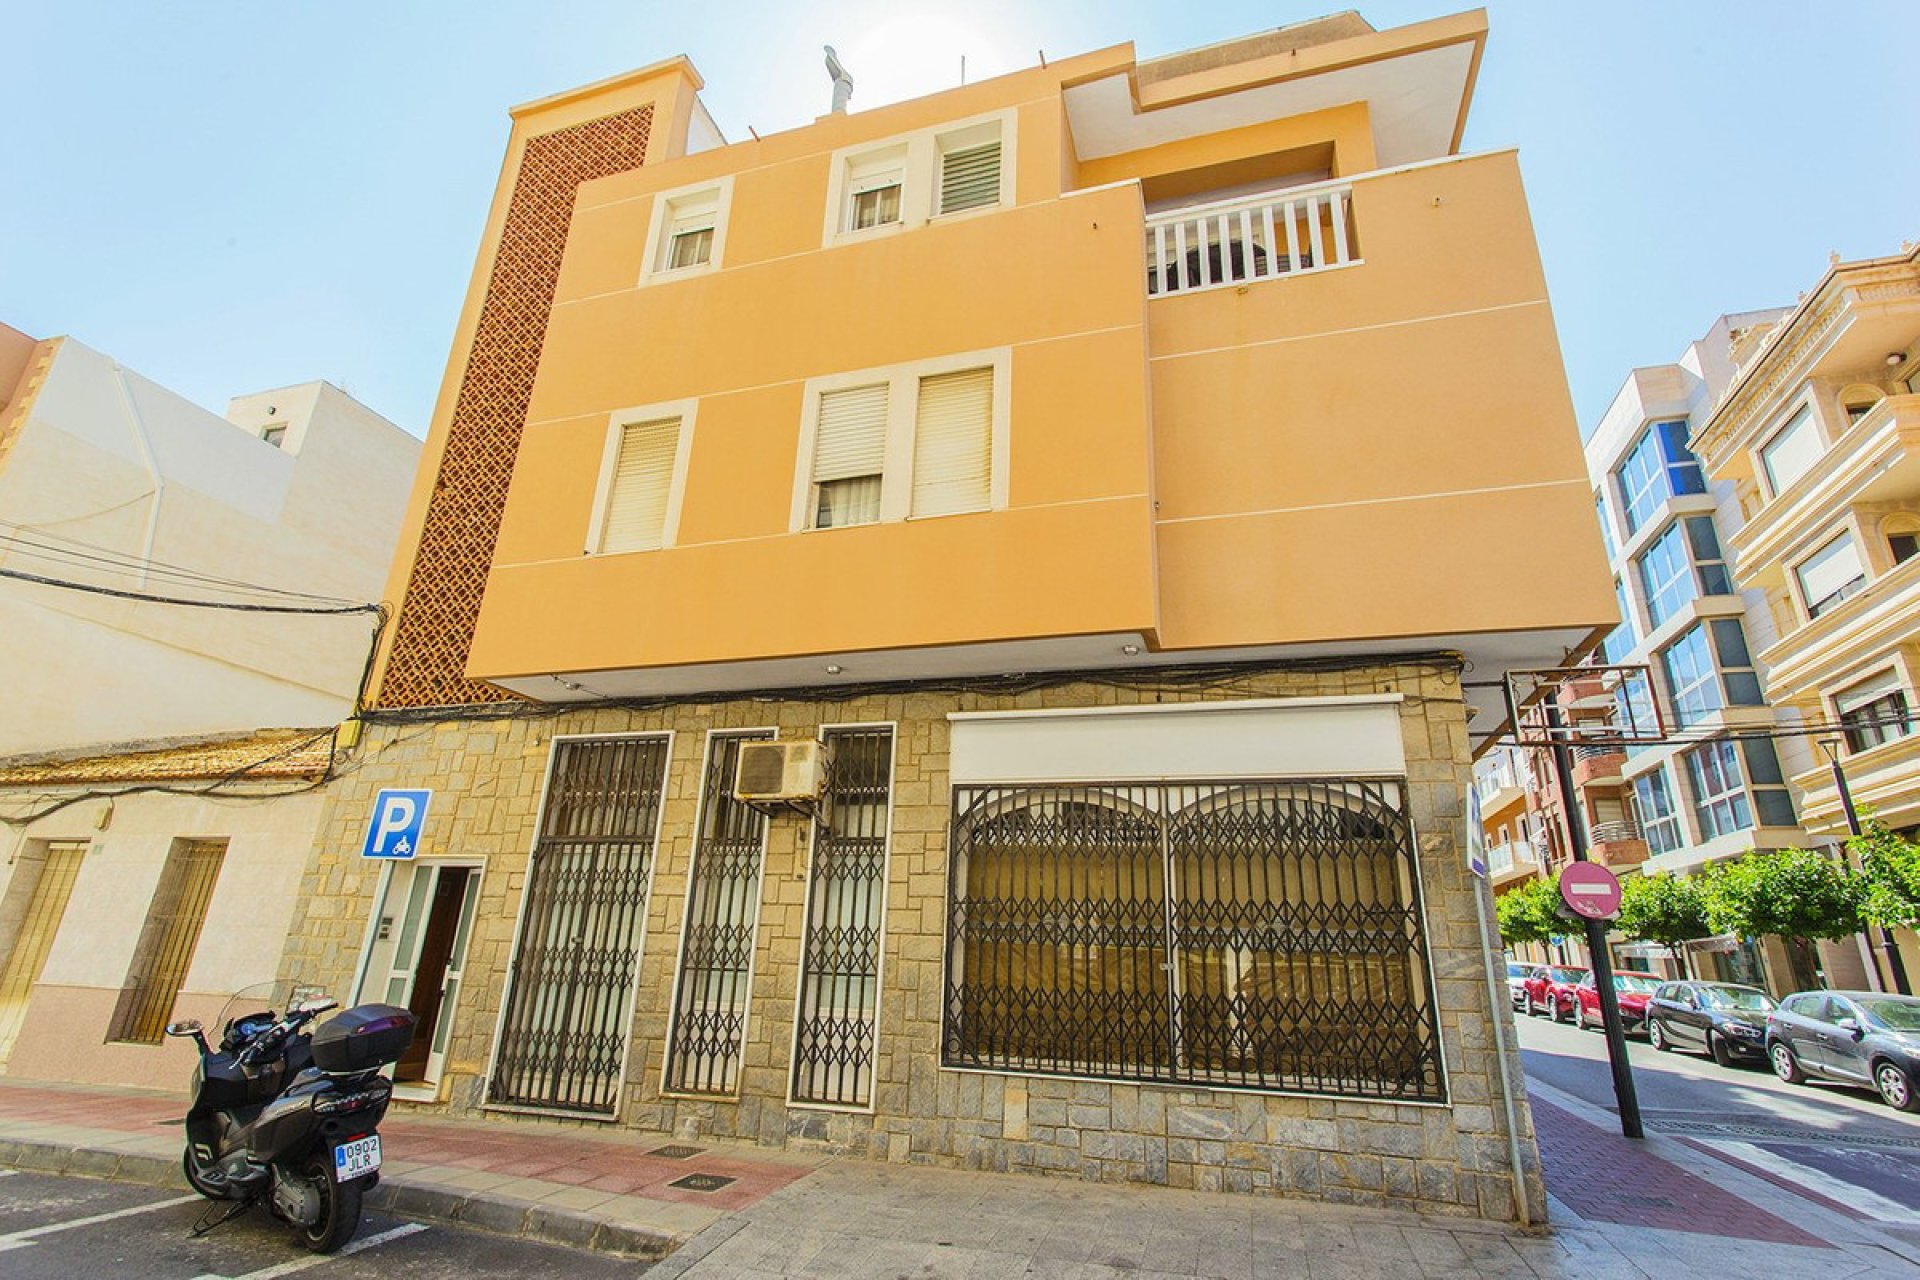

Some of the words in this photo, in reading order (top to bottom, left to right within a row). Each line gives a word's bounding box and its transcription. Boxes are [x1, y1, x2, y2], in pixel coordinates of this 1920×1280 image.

[372, 797, 416, 853] P
[346, 1138, 377, 1159] 0902
[348, 1154, 371, 1172] JLR
